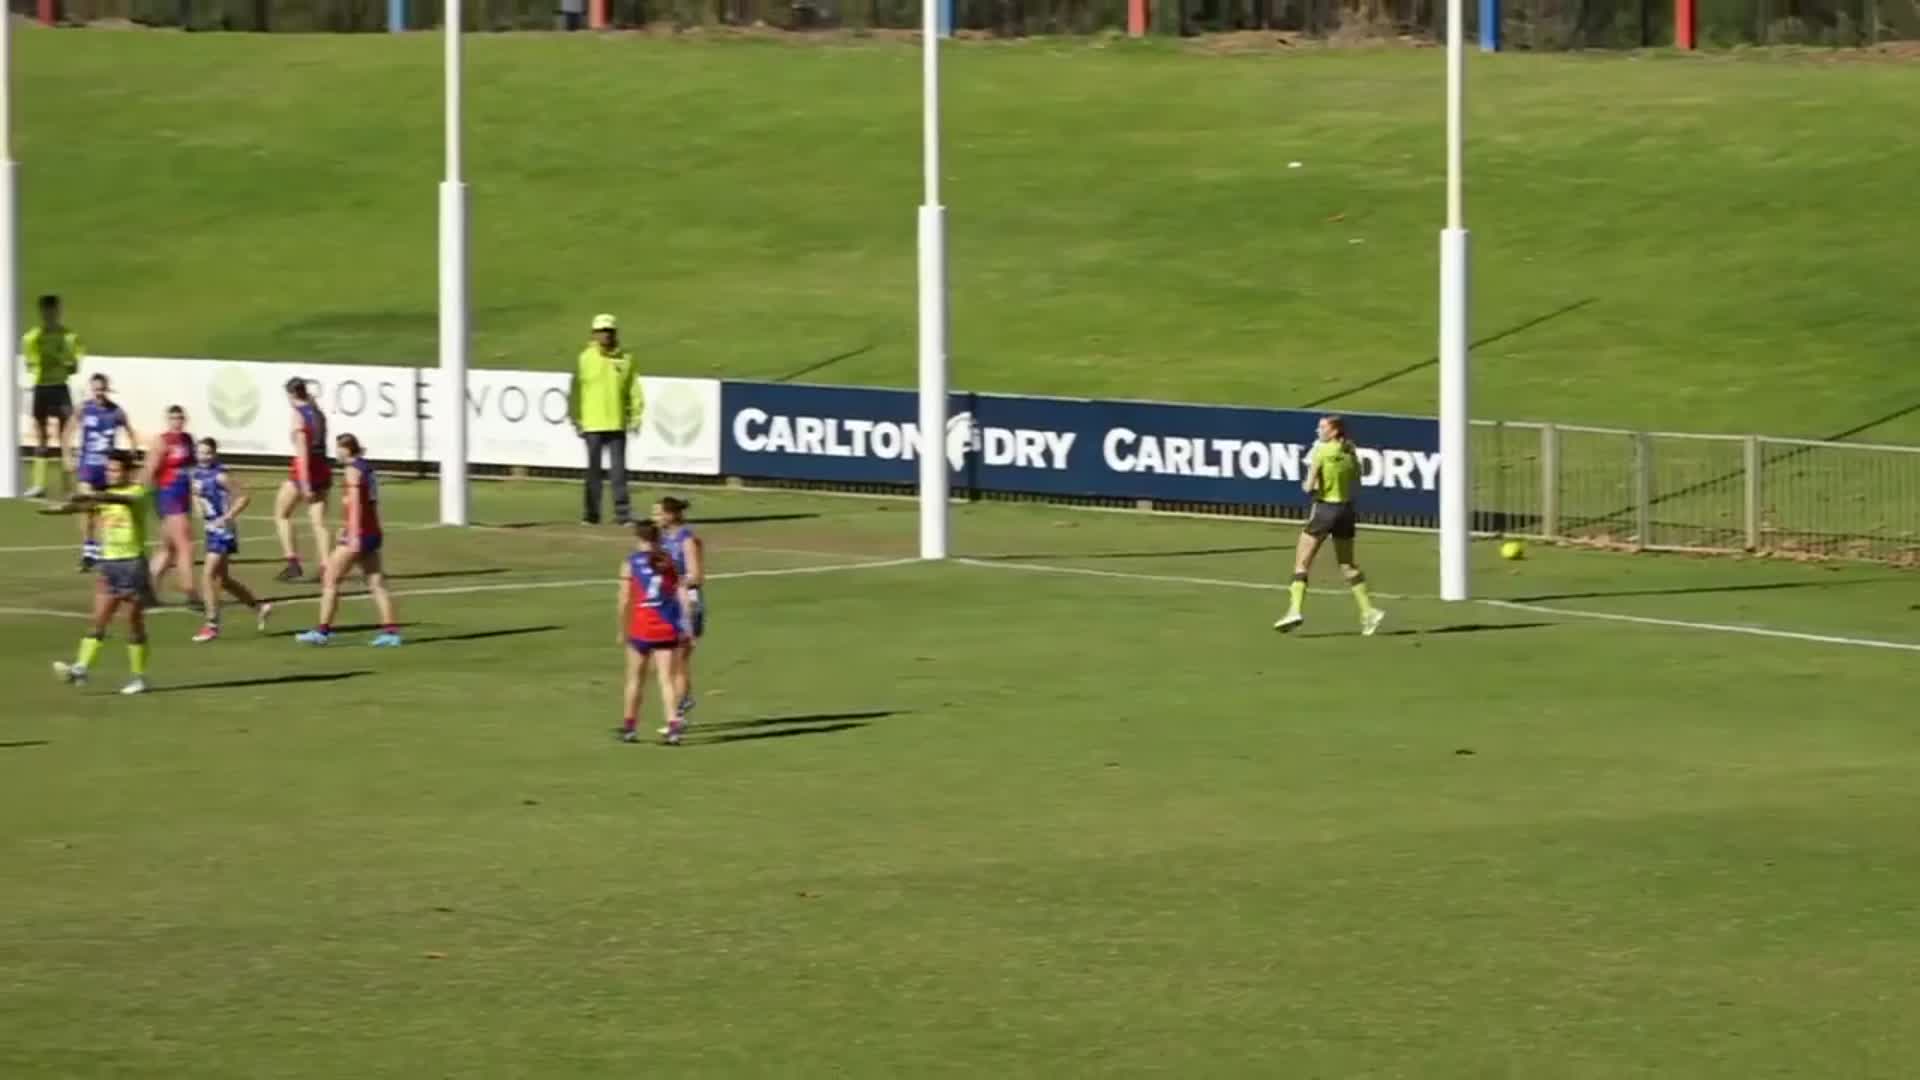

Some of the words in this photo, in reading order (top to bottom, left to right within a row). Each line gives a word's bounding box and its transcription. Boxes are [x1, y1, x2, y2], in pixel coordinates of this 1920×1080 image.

[733, 408, 922, 461] CARLTON
[983, 427, 1076, 470] DRY
[1103, 427, 1299, 481] CARLTON
[1355, 447, 1441, 491] DRY
